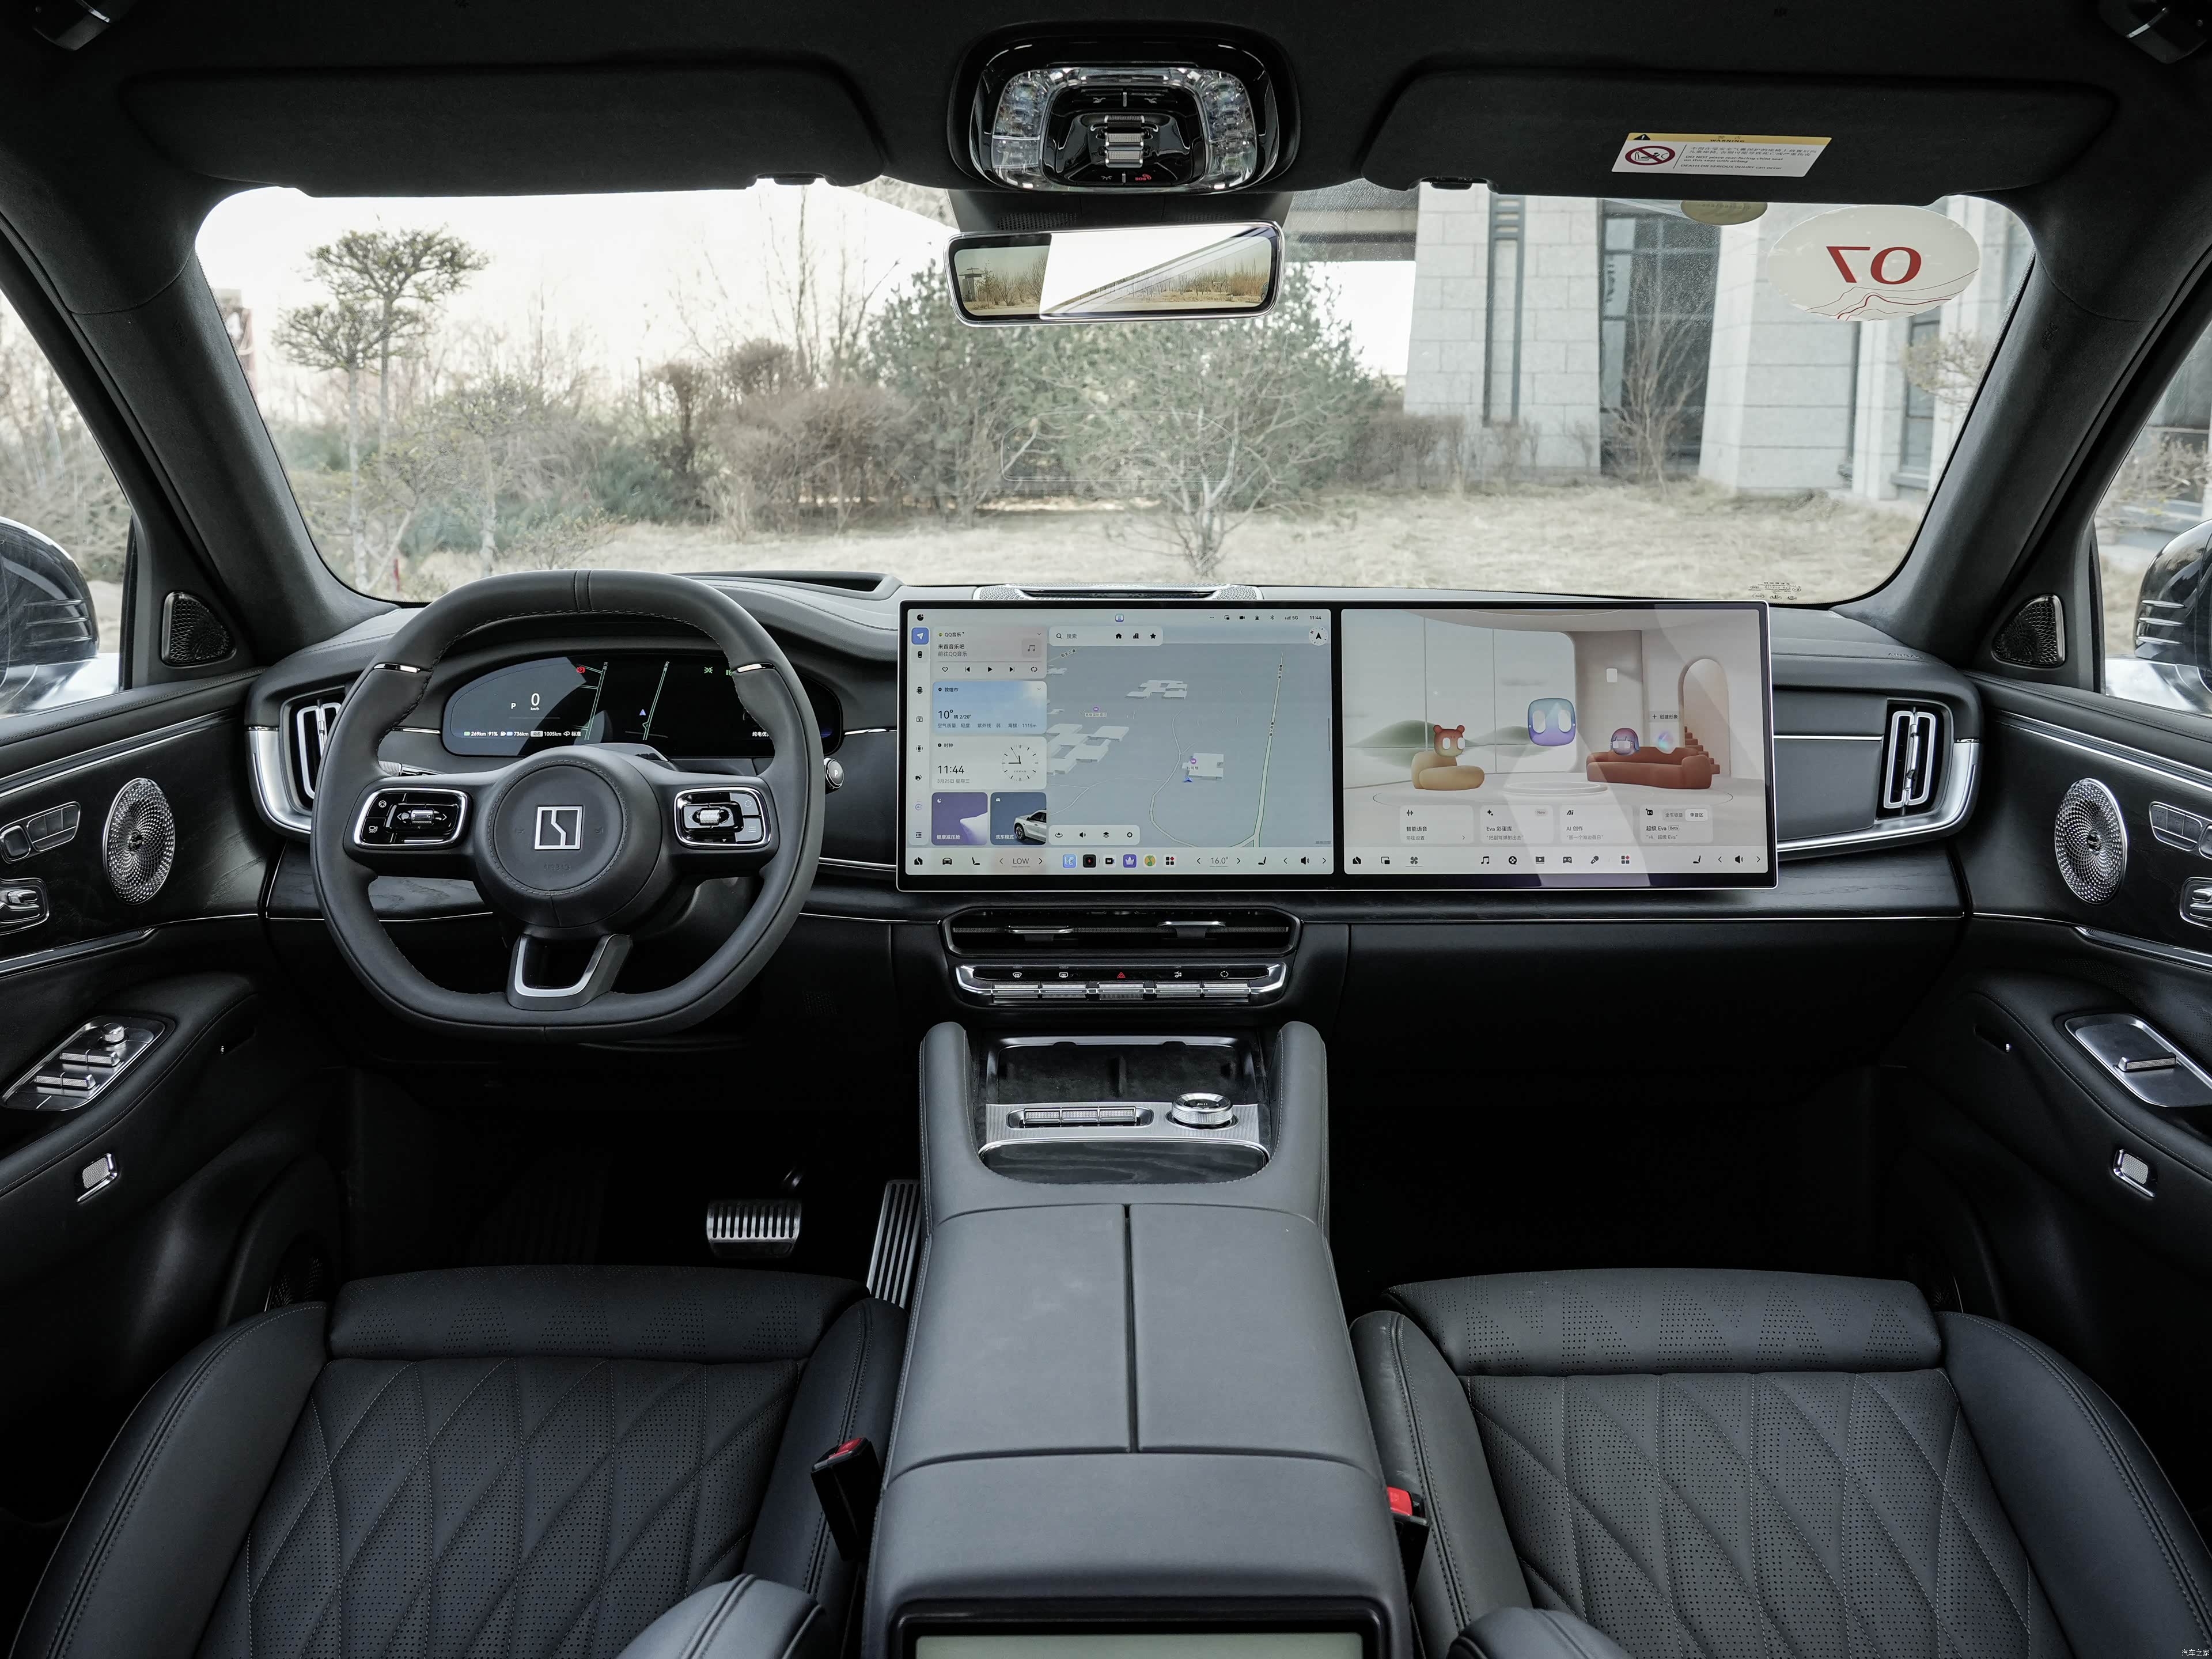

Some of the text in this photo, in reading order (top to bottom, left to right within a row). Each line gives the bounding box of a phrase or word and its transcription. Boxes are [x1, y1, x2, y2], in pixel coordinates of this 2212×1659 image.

[531, 693, 540, 706] 0
[834, 769, 838, 777] P
[938, 765, 965, 774] 11:44
[1210, 856, 1229, 865] 16.0°
